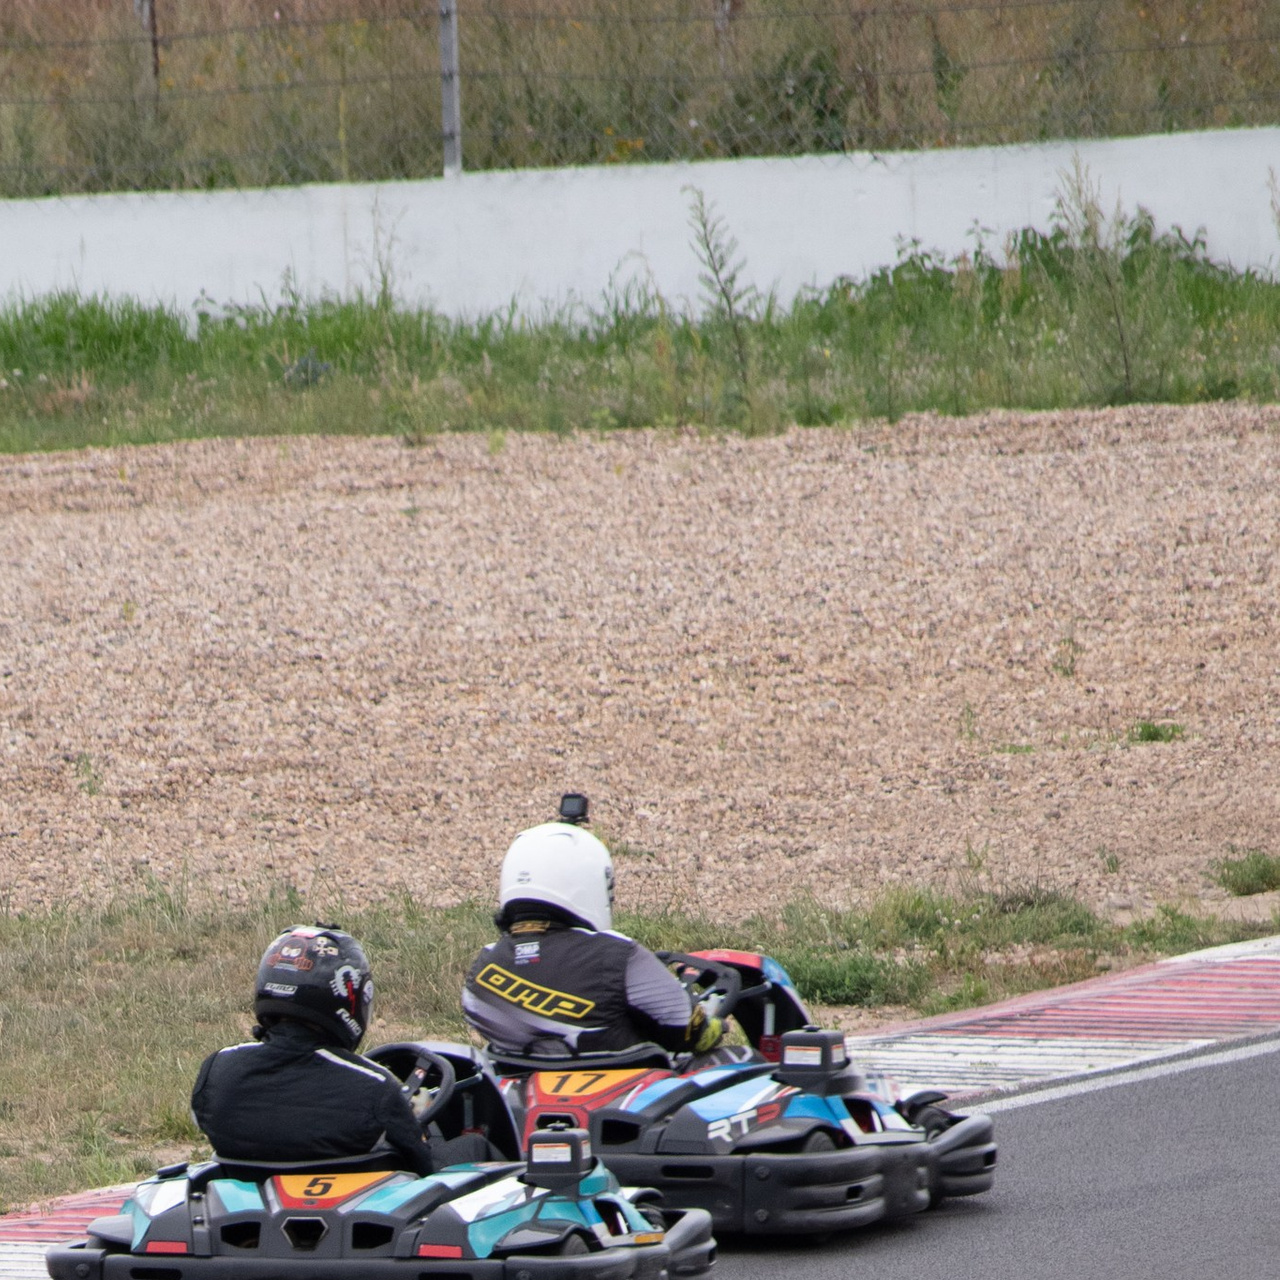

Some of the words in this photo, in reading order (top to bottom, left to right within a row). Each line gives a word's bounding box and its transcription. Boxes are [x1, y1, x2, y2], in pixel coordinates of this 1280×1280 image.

[476, 963, 596, 1018] OMP
[555, 1072, 609, 1095] 17
[303, 1176, 337, 1197] 5
